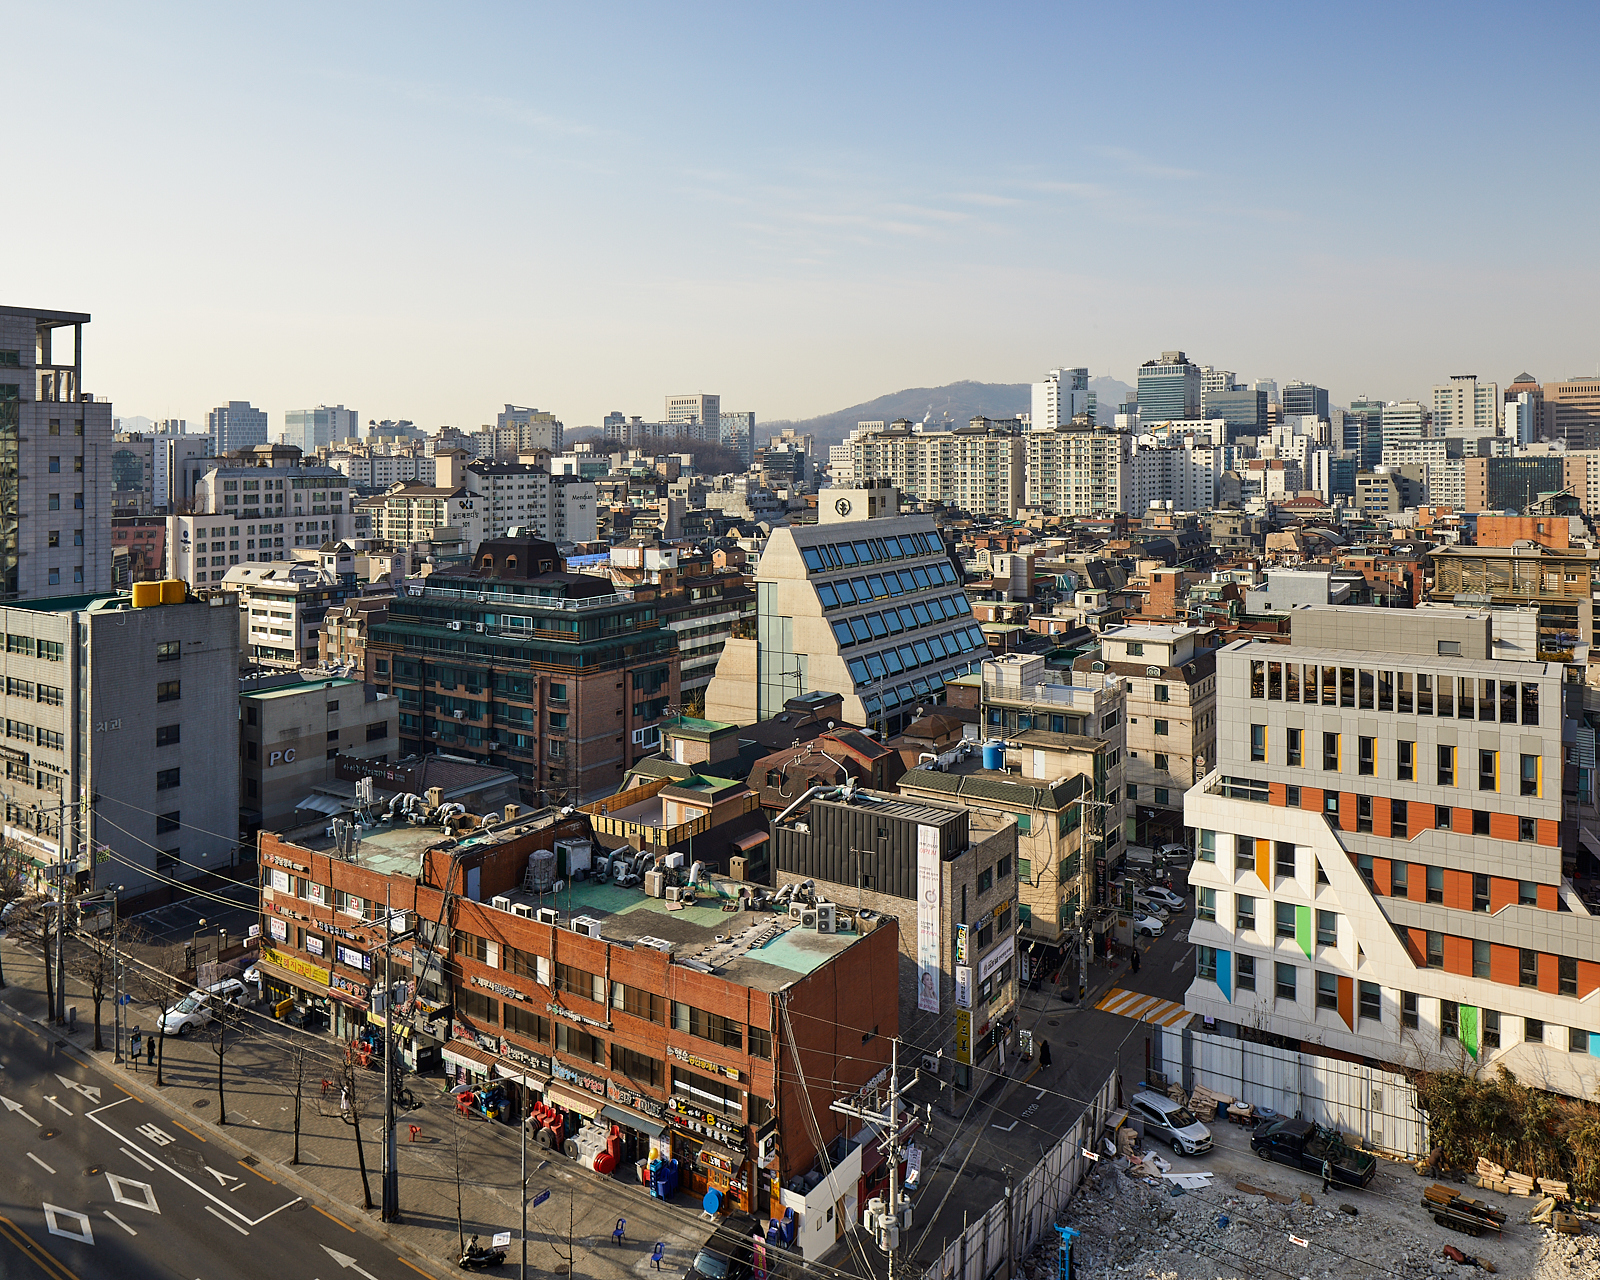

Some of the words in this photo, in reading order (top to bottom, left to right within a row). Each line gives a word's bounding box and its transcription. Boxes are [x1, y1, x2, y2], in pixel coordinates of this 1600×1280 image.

[572, 491, 593, 500] Meridian
[96, 718, 122, 732] 치과
[269, 748, 296, 766] PC
[707, 1113, 732, 1132] Beer
